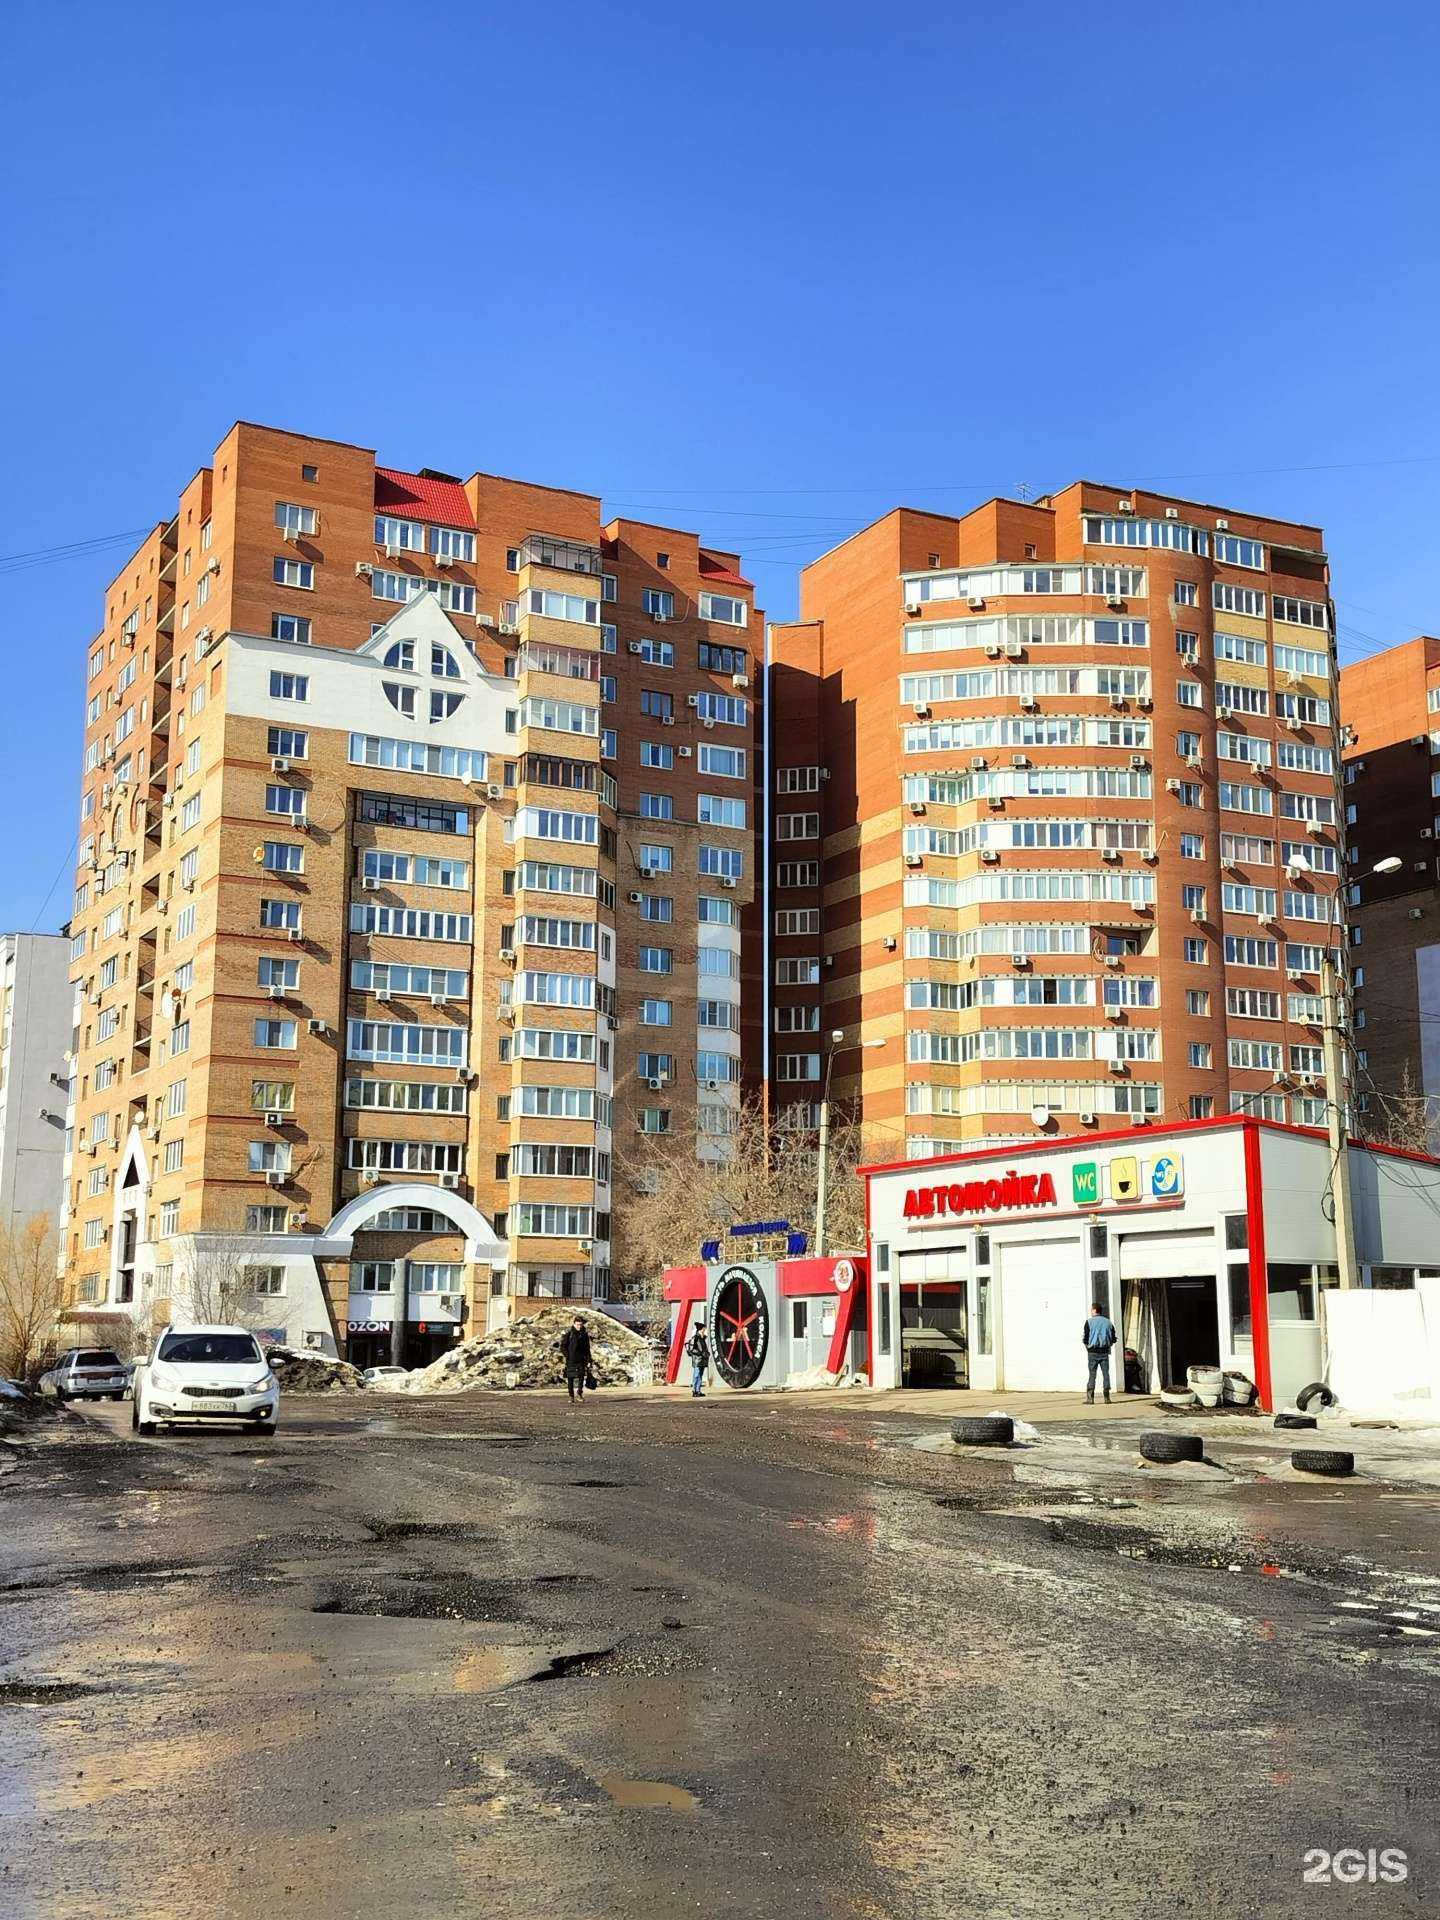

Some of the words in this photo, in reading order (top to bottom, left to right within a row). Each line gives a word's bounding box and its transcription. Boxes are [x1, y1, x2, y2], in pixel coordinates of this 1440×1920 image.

[1074, 1173, 1095, 1191] WC
[904, 1171, 1056, 1217] АВТОМОЙКА
[348, 1321, 390, 1332] OZON
